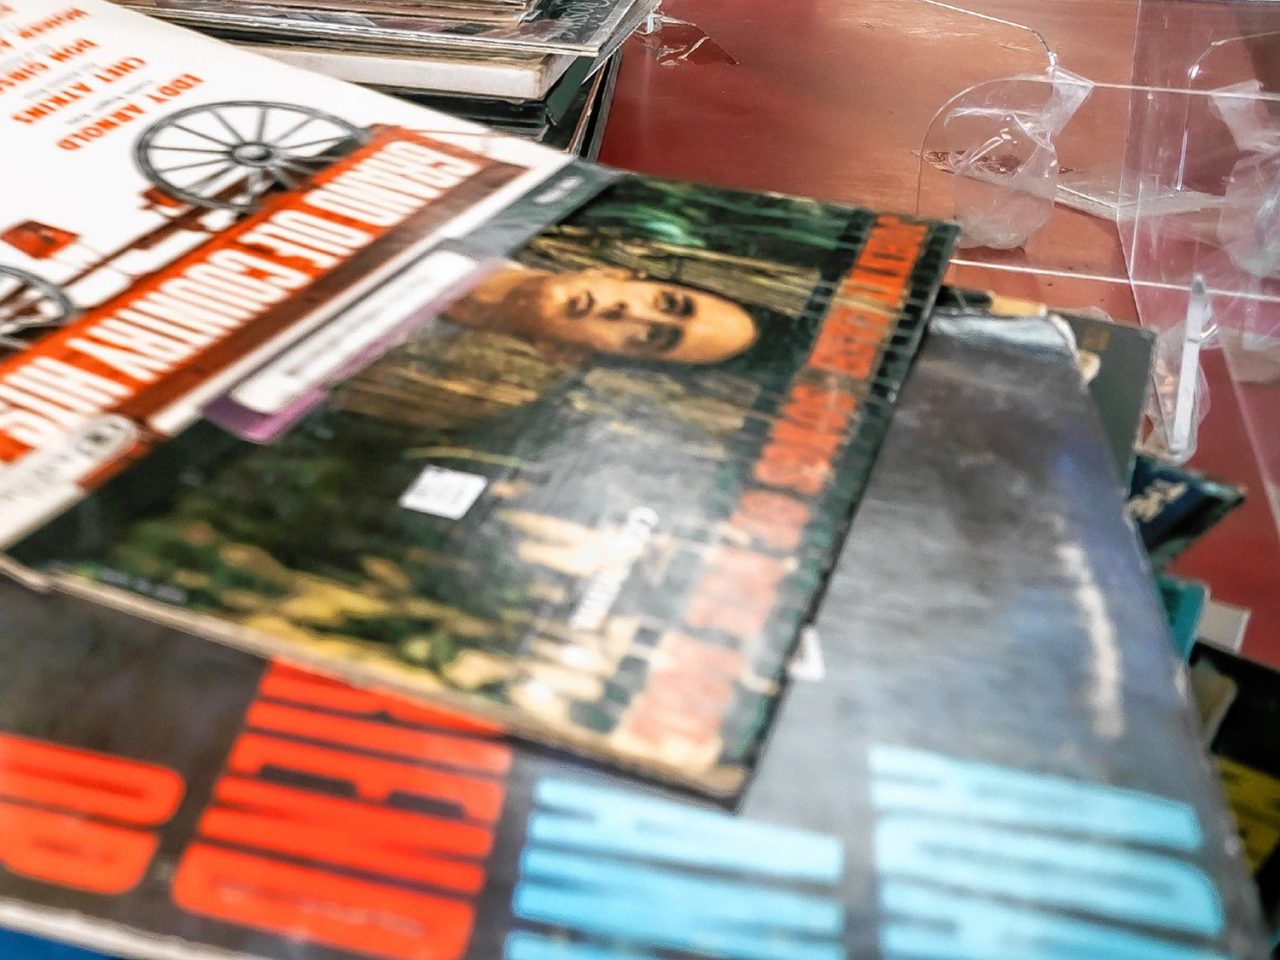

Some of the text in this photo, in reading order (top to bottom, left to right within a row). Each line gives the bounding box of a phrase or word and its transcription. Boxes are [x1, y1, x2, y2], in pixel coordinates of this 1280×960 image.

[10, 55, 147, 125] CHET ATKINS
[49, 38, 100, 64] DON
[55, 73, 206, 151] EDDY ARNOLD
[303, 139, 483, 229] GRAND
[238, 208, 375, 271] OLE
[65, 248, 314, 382] COUNTRY
[172, 656, 514, 960] RIEND
[505, 777, 844, 960] AN
